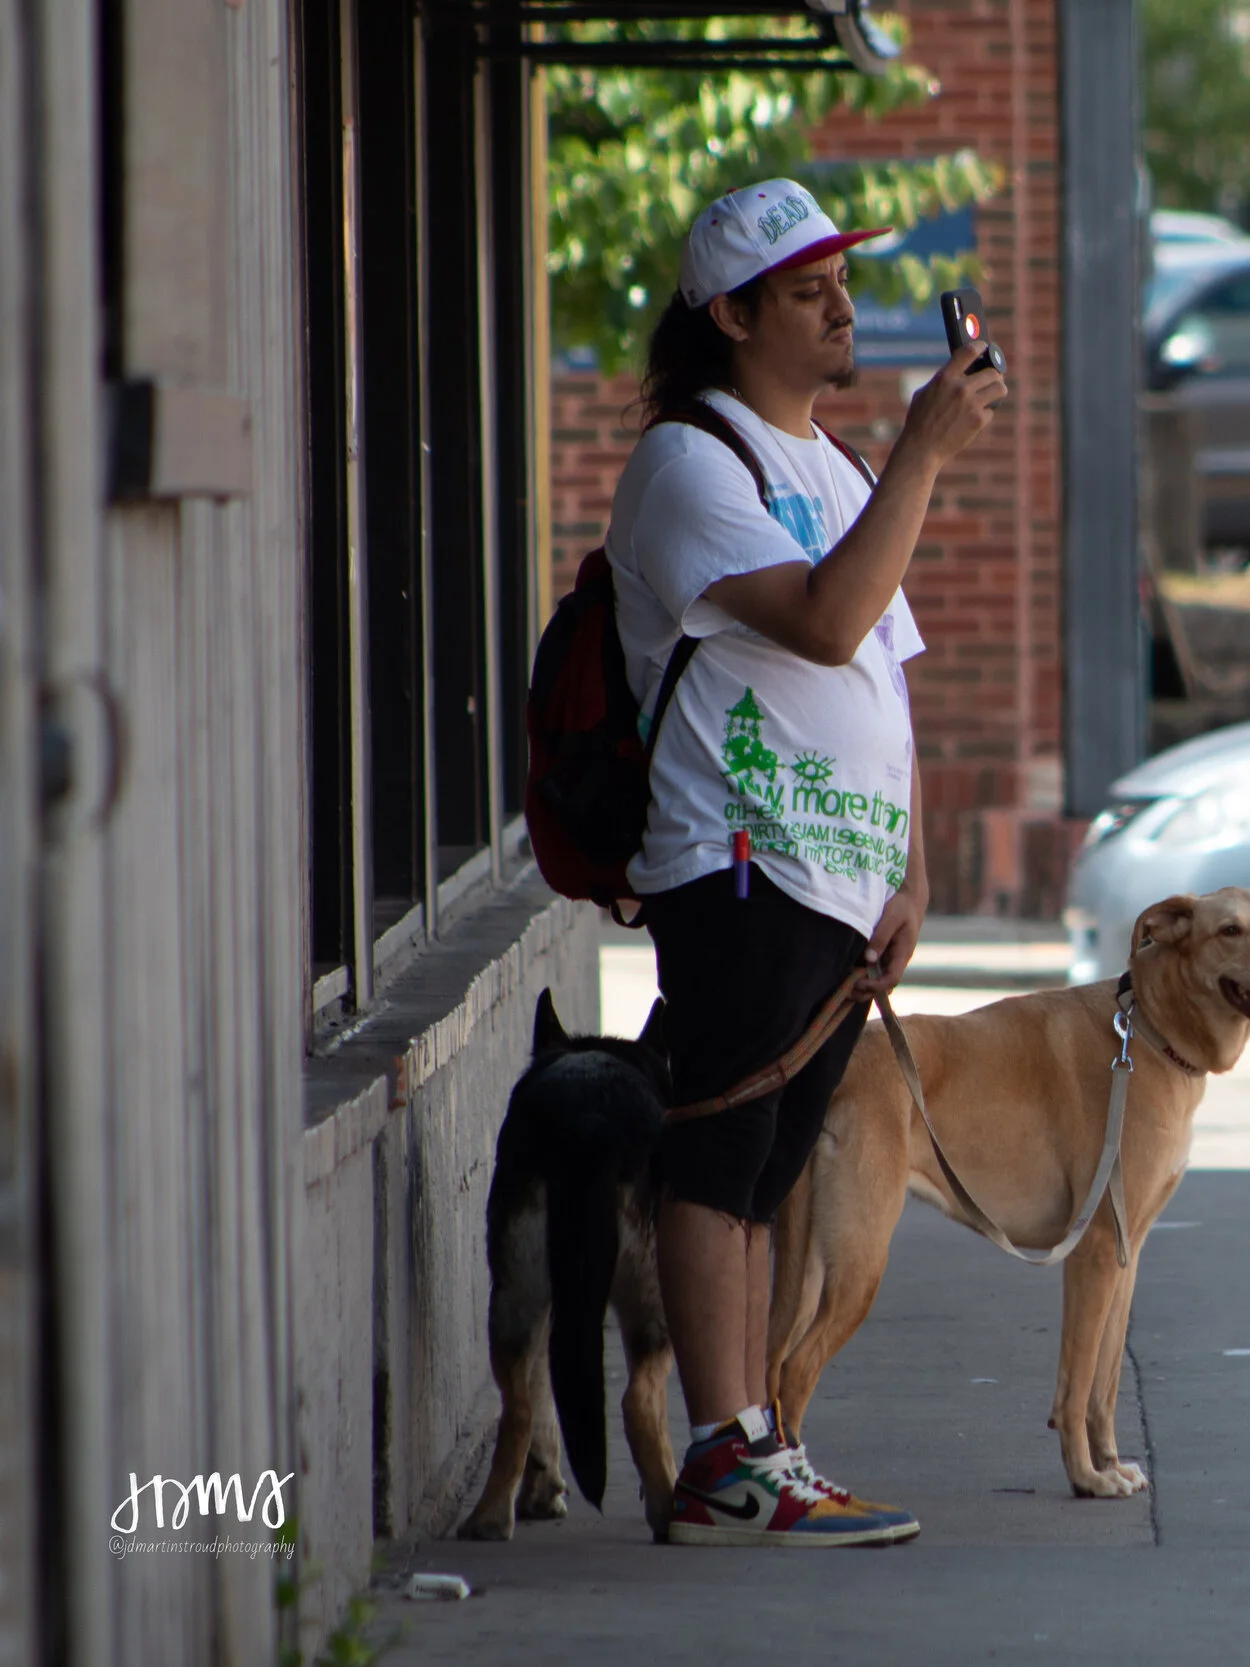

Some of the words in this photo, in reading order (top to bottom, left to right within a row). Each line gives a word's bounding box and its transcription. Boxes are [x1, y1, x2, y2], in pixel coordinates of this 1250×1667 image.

[757, 195, 809, 245] DEAD
[792, 786, 868, 821] more
[871, 790, 908, 838] than
